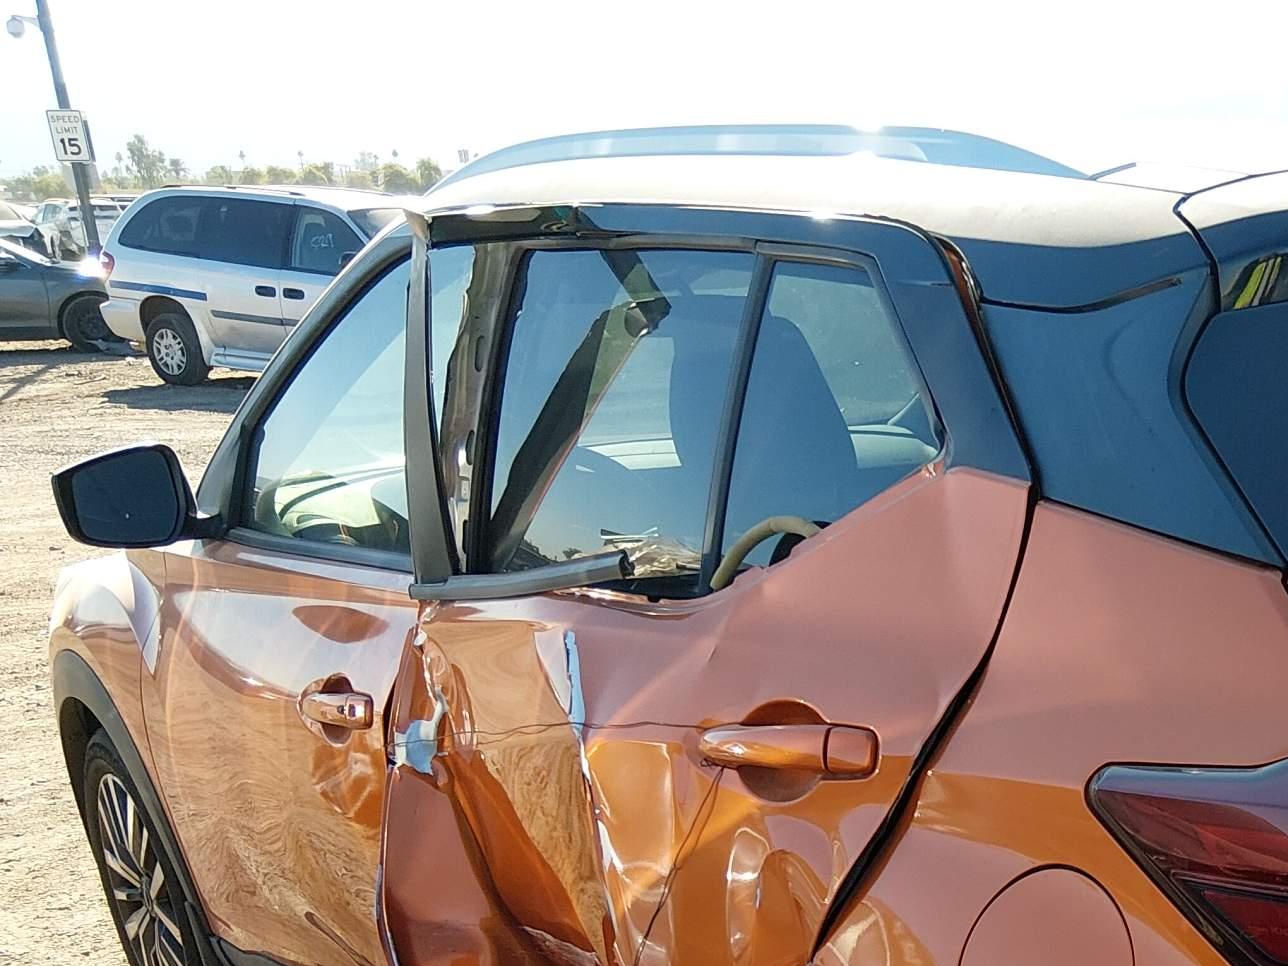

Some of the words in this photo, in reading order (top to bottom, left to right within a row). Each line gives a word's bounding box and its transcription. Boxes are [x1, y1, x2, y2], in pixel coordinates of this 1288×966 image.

[51, 115, 80, 123] SPEED
[56, 126, 78, 134] LIMIT
[60, 137, 82, 156] 15
